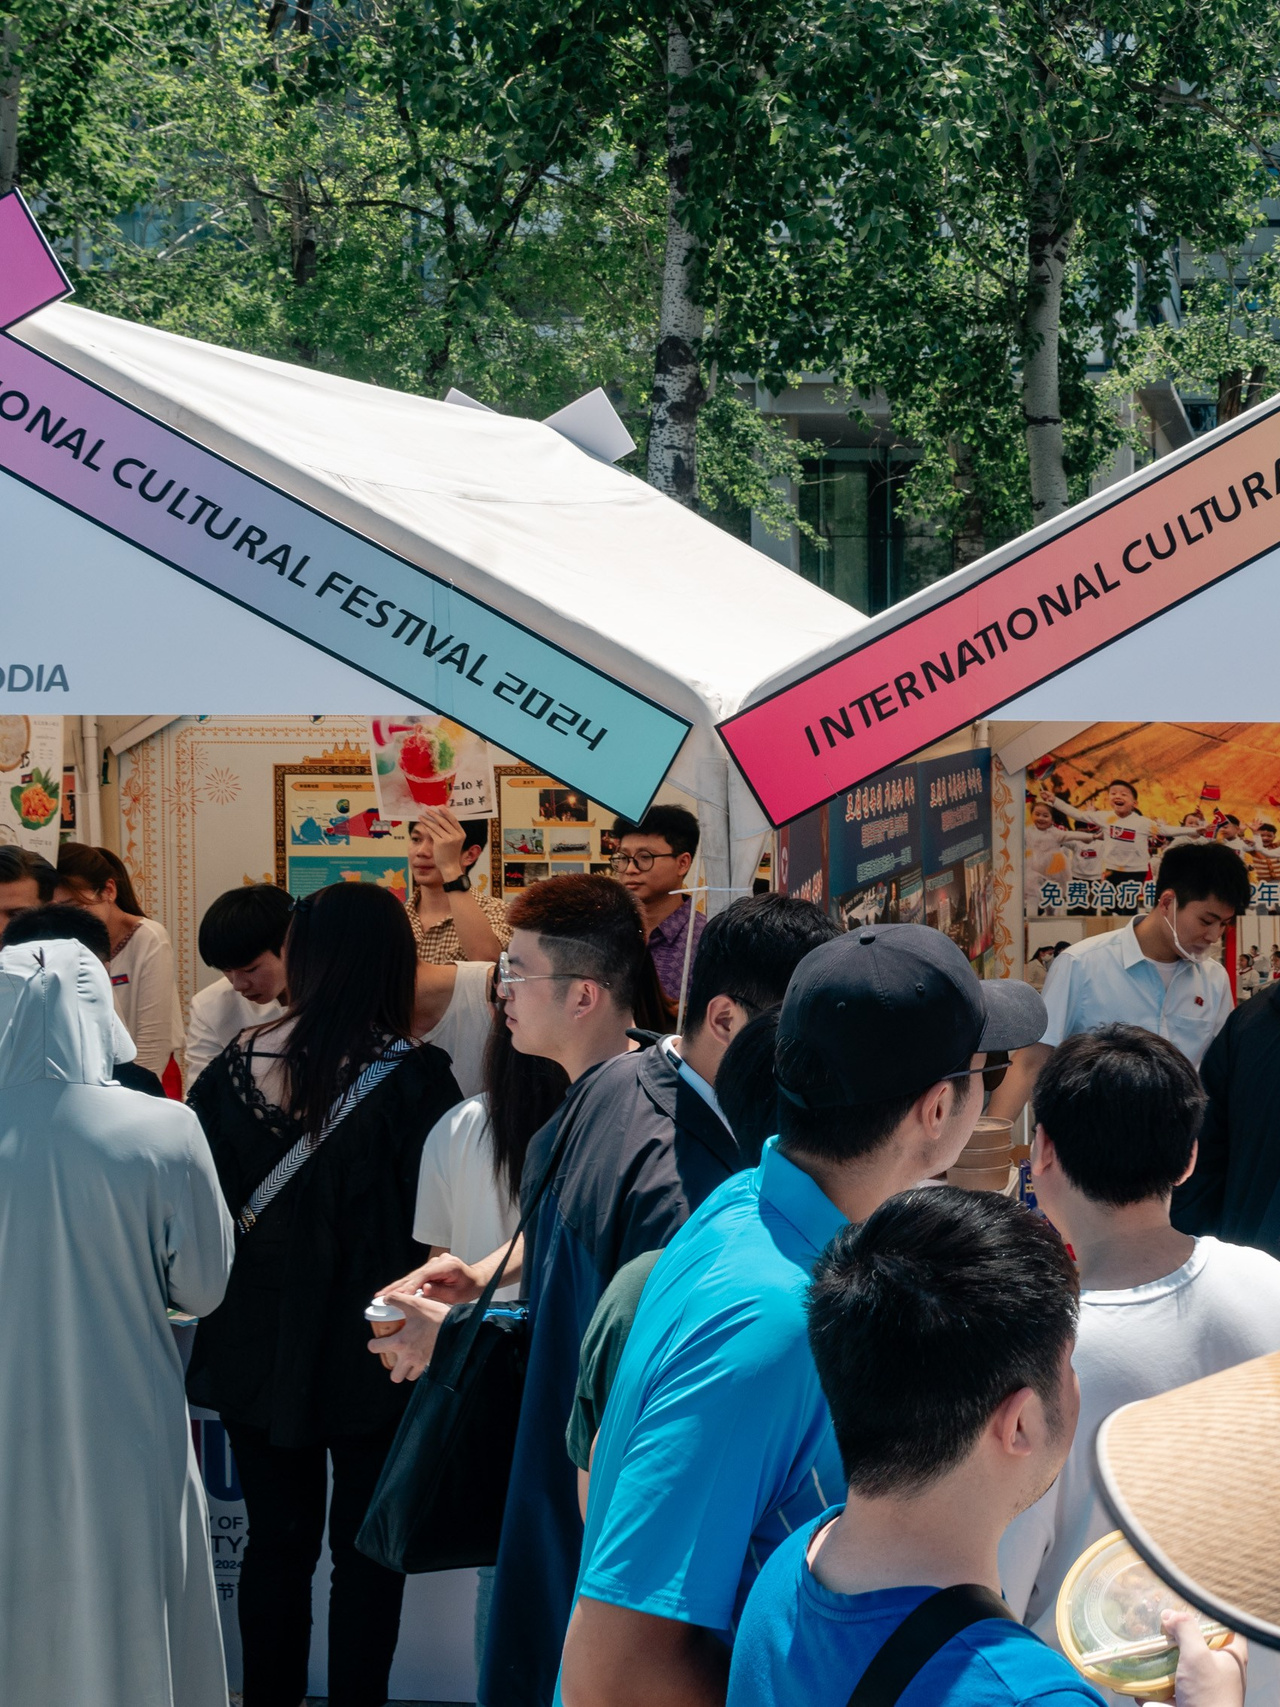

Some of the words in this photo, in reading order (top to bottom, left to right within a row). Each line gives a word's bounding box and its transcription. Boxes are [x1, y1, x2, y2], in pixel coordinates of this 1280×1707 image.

[0, 381, 105, 473] ONAL
[112, 458, 308, 589] CULTURAL
[314, 570, 486, 687] FESTIVAL
[492, 670, 608, 752] 2024
[803, 561, 1121, 757] INTERNATIONAL
[0, 664, 69, 692] DIA
[217, 1516, 243, 1530] OF
[211, 1535, 243, 1554] TY
